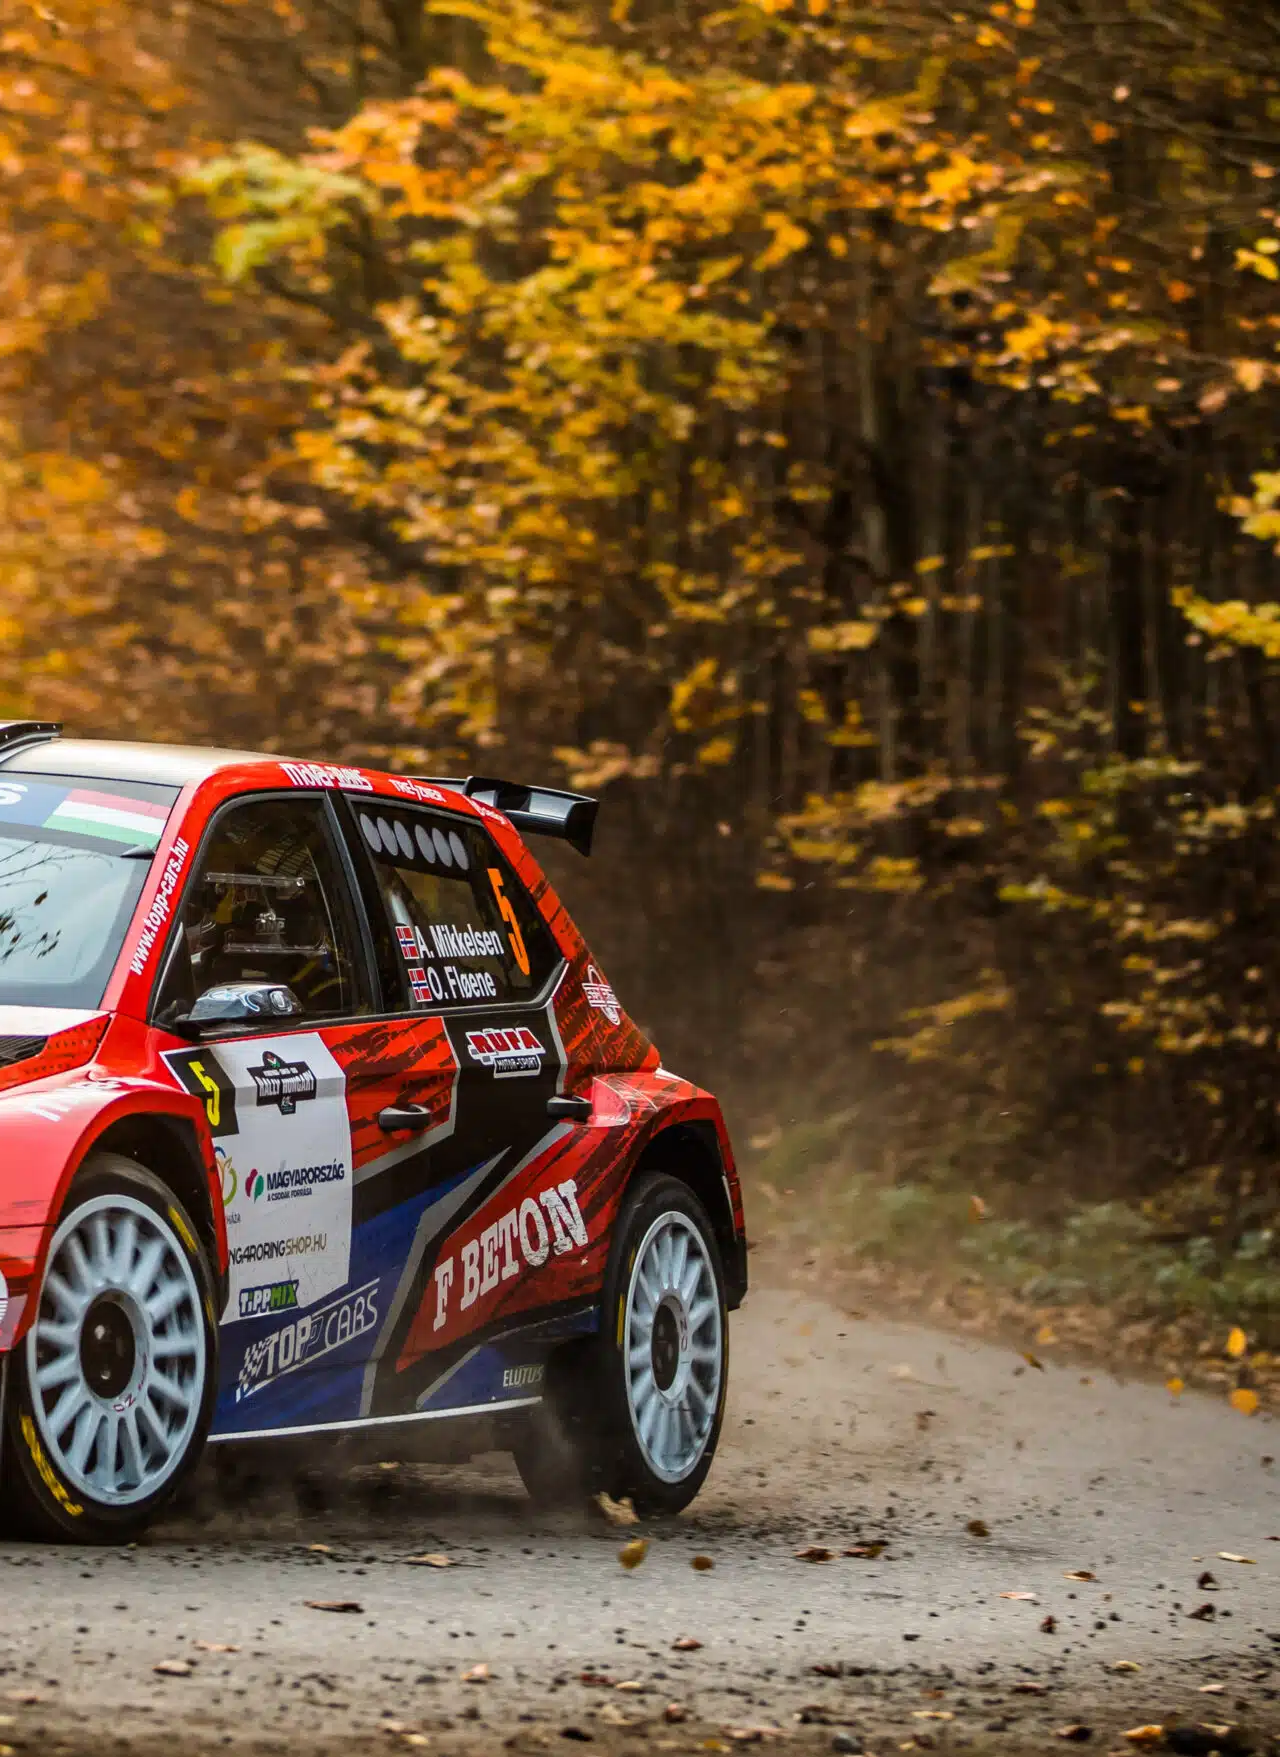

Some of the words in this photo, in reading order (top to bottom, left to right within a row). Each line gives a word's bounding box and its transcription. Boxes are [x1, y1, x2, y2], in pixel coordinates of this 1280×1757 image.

[130, 836, 190, 976] www.topp-cars.hu
[486, 867, 531, 976] 5
[414, 925, 435, 959] A.
[429, 923, 505, 958] Mikkelsen
[426, 966, 449, 1001] O.
[444, 965, 497, 999] Fløene
[189, 1061, 220, 1126] 5
[254, 1076, 280, 1097] RALLY
[281, 1070, 315, 1094] HUNGARY
[267, 1158, 345, 1191] MAGYARORSZÁG
[433, 1257, 454, 1332] F
[460, 1179, 589, 1311] BETON
[324, 1288, 378, 1350] CARS
